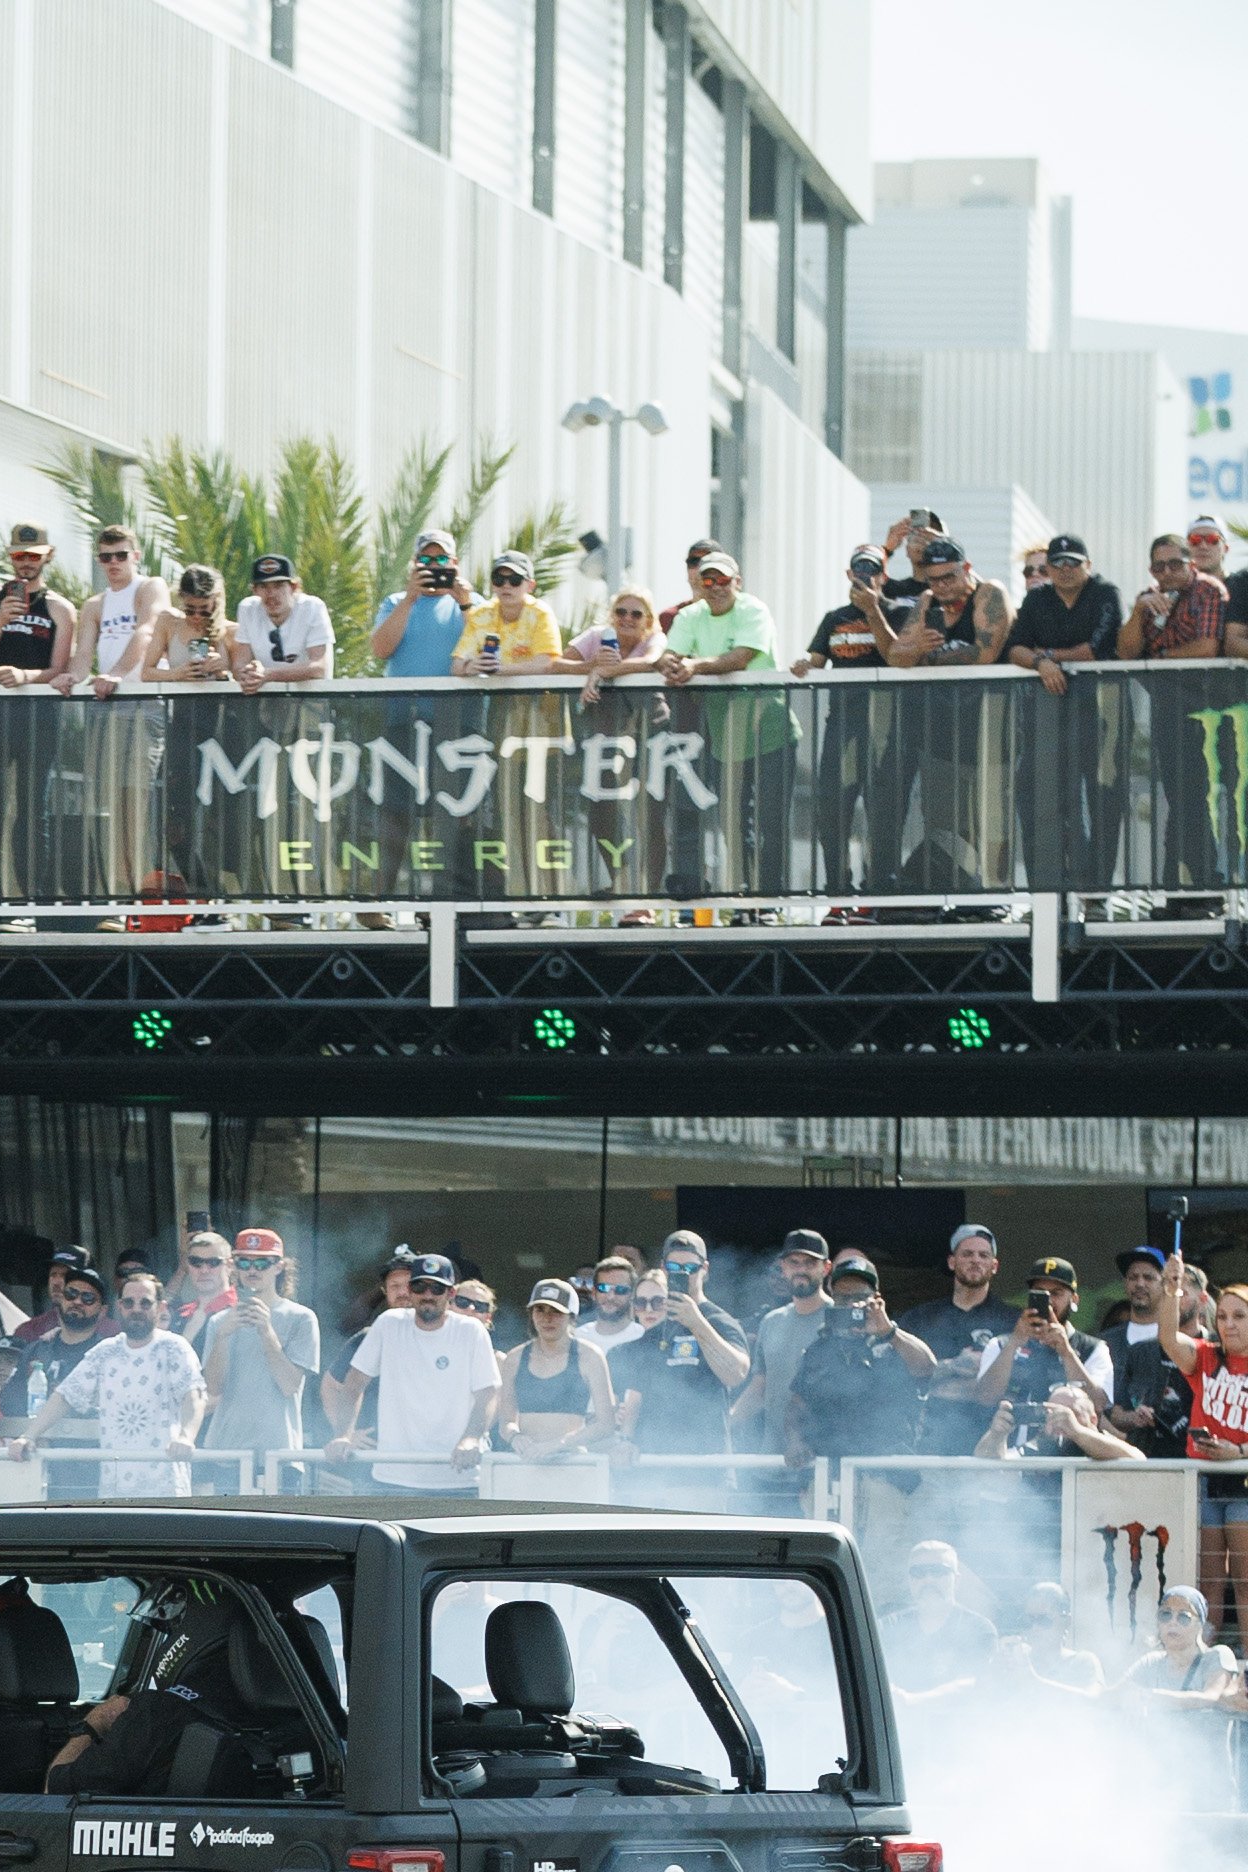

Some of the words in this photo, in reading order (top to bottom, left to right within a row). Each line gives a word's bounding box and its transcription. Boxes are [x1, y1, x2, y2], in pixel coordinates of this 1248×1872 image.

[197, 721, 719, 822] MONSTER
[280, 838, 634, 871] ENERGY
[1044, 1259, 1057, 1274] P
[155, 1633, 190, 1679] MONSTER
[72, 1820, 177, 1857] MAHLE
